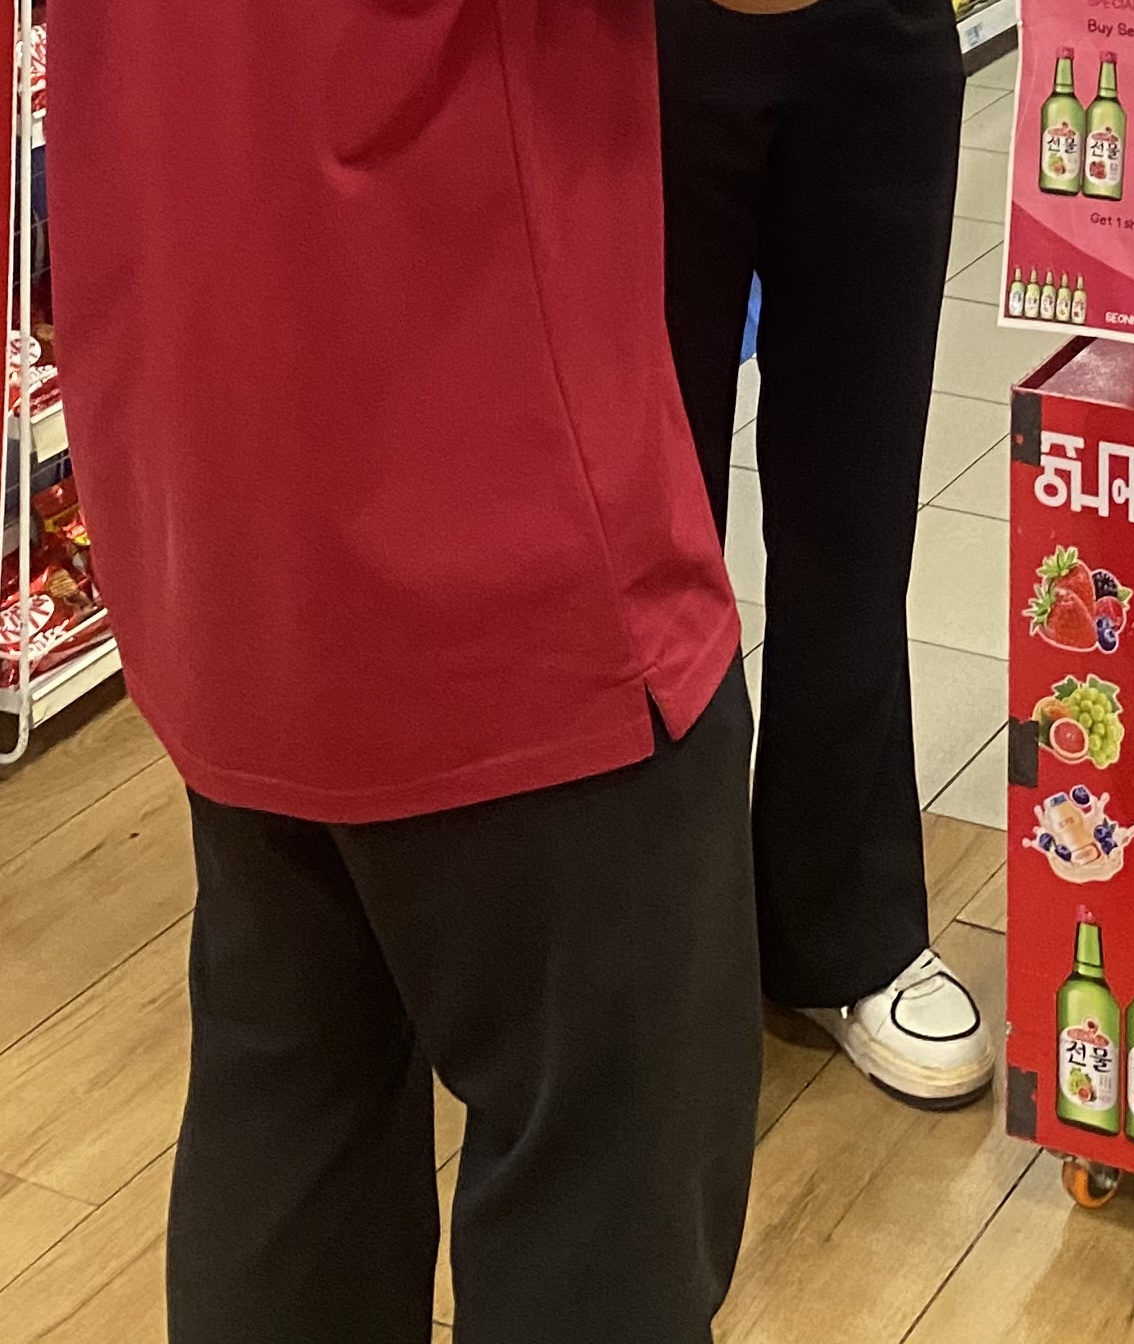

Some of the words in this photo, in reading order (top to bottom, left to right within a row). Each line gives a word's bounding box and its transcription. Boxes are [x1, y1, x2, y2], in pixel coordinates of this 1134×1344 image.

[1087, 18, 1113, 38] Buy
[1090, 212, 1112, 227] Get
[1065, 1040, 1113, 1073] 선물
